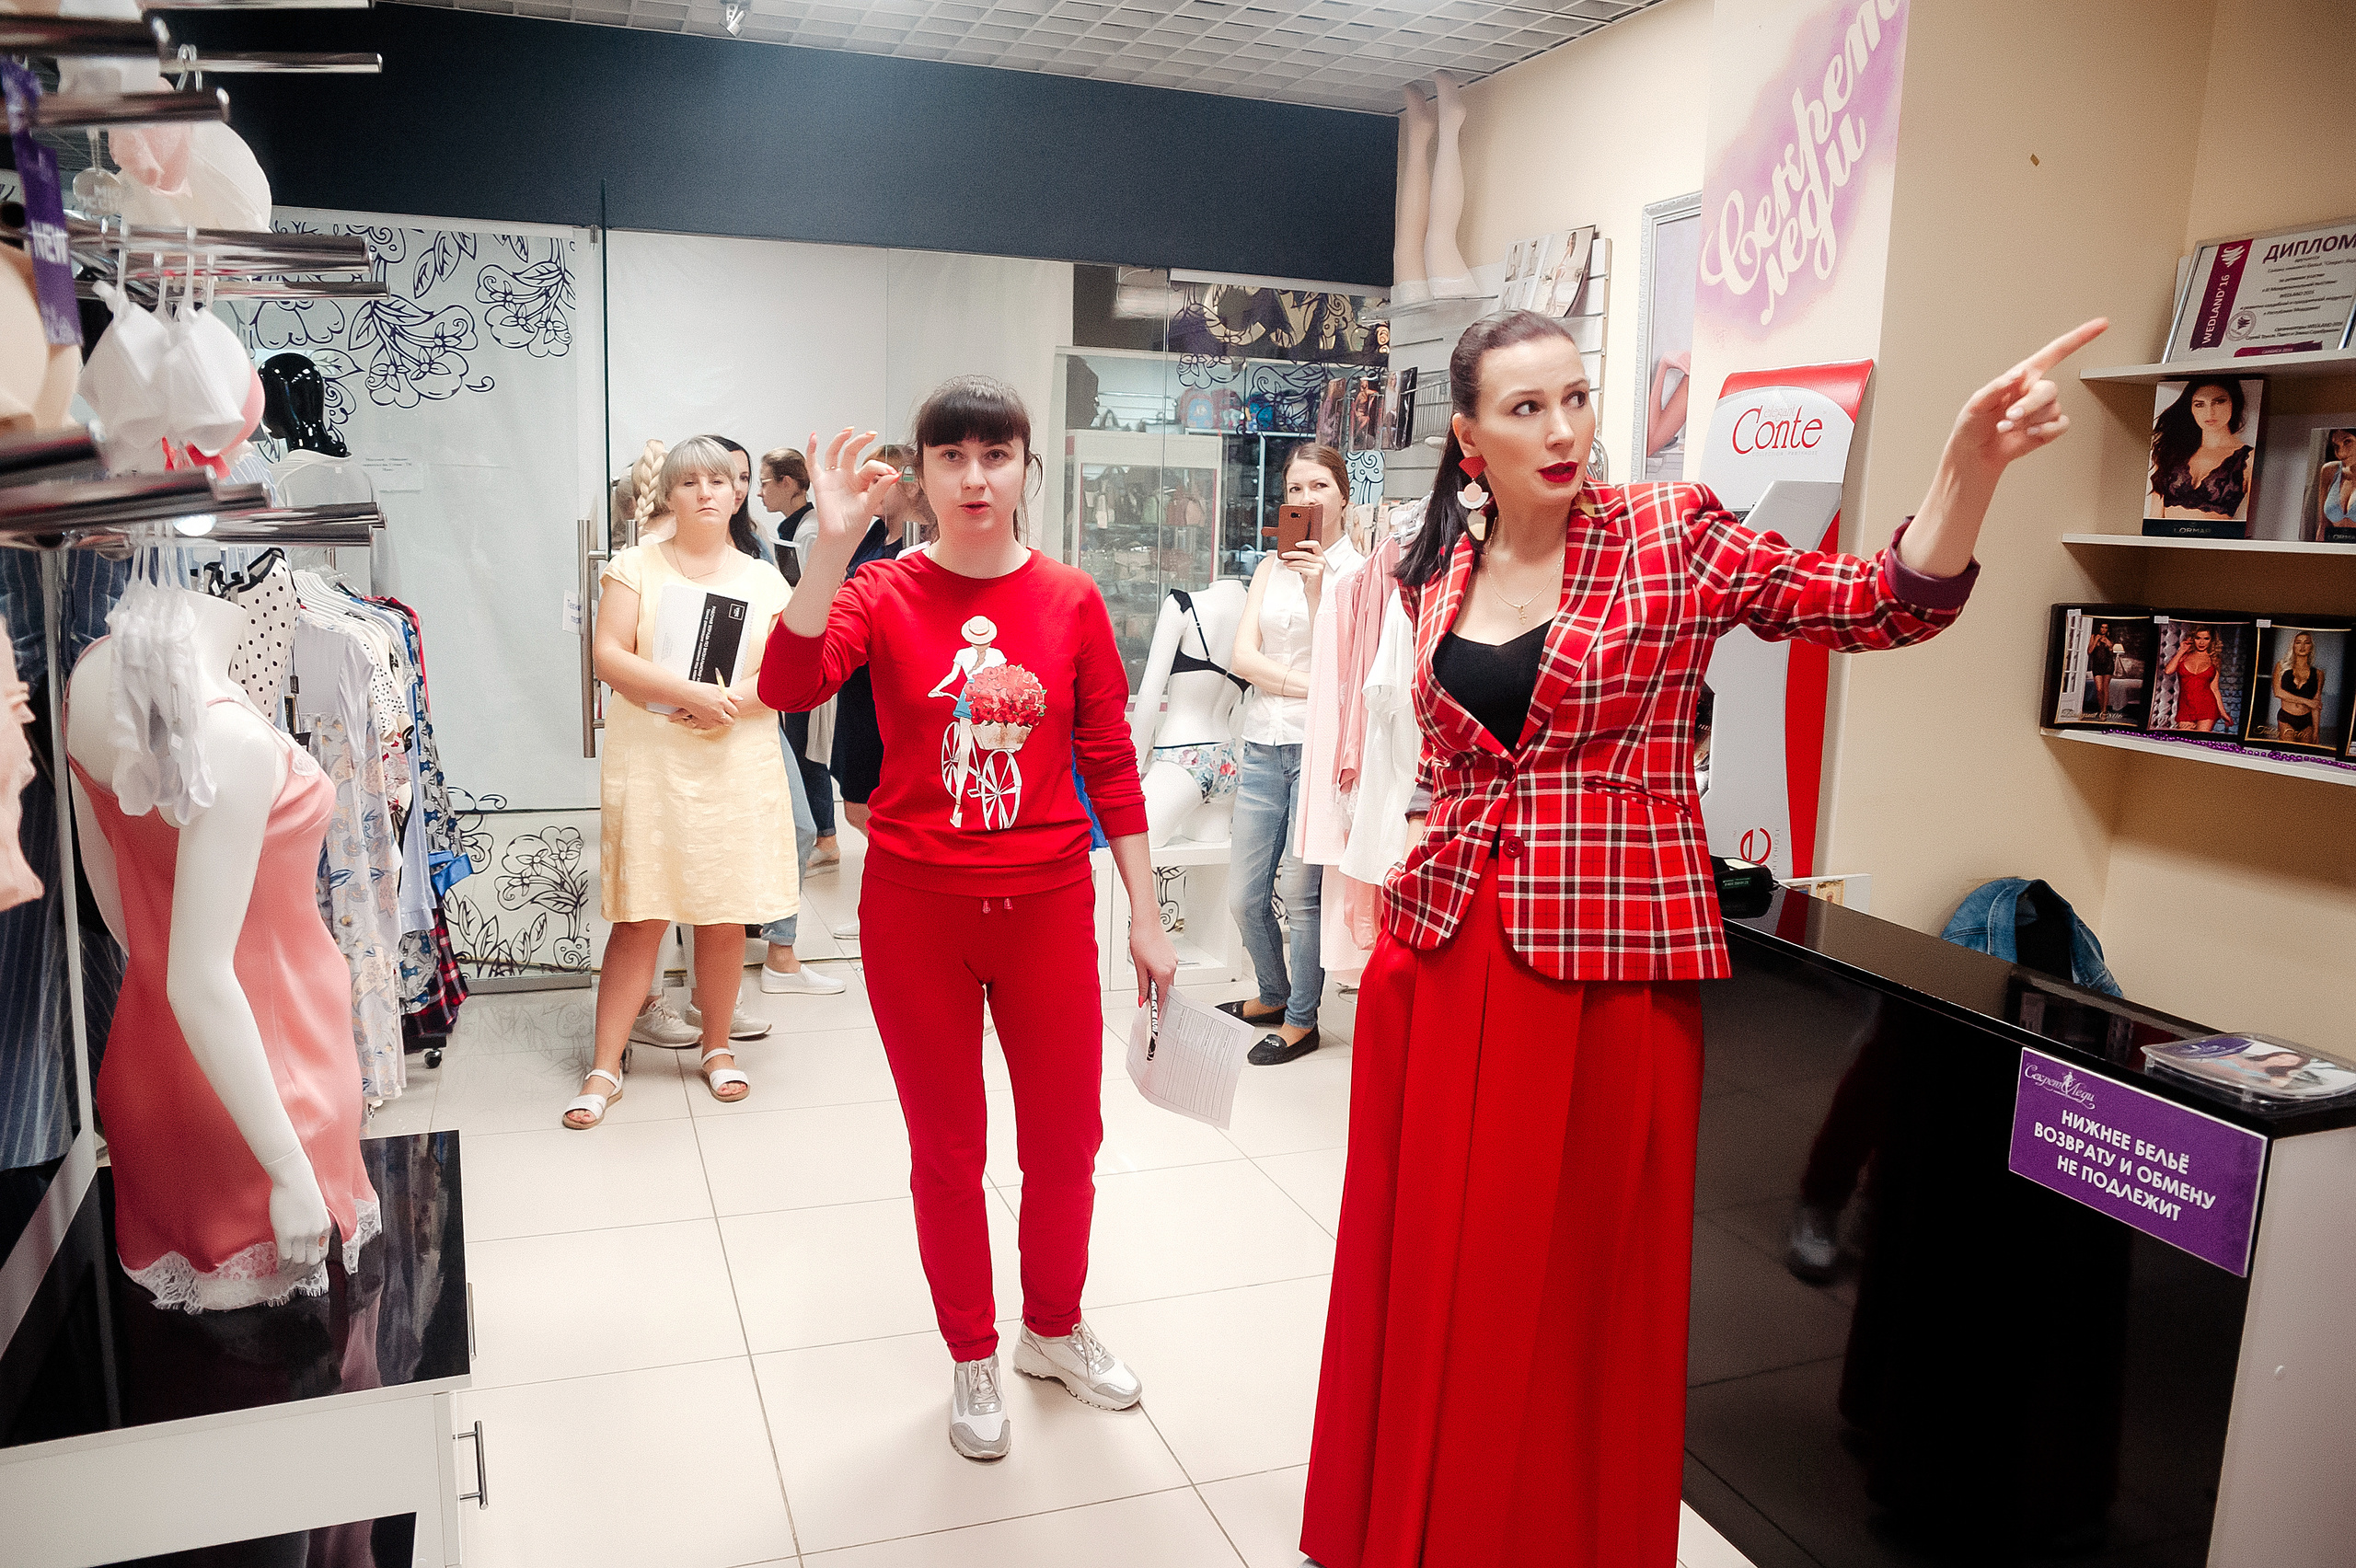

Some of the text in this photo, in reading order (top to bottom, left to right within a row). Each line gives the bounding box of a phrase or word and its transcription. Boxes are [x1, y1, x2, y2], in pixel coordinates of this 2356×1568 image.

[30, 220, 69, 265] NEW
[2262, 234, 2356, 264] ДИПЛОМ
[2201, 274, 2230, 344] WEDLAND'16
[1732, 405, 1823, 455] Conte
[2024, 1064, 2063, 1091] Секрет
[2034, 1122, 2216, 1209] ВОЗВРАТУ И ОБМЕНУ
[2062, 1110, 2189, 1174] НИЖНЕЕ БЕЛЬЁ
[2057, 1155, 2182, 1221] НЕ ПОДЛЕЖИТ
